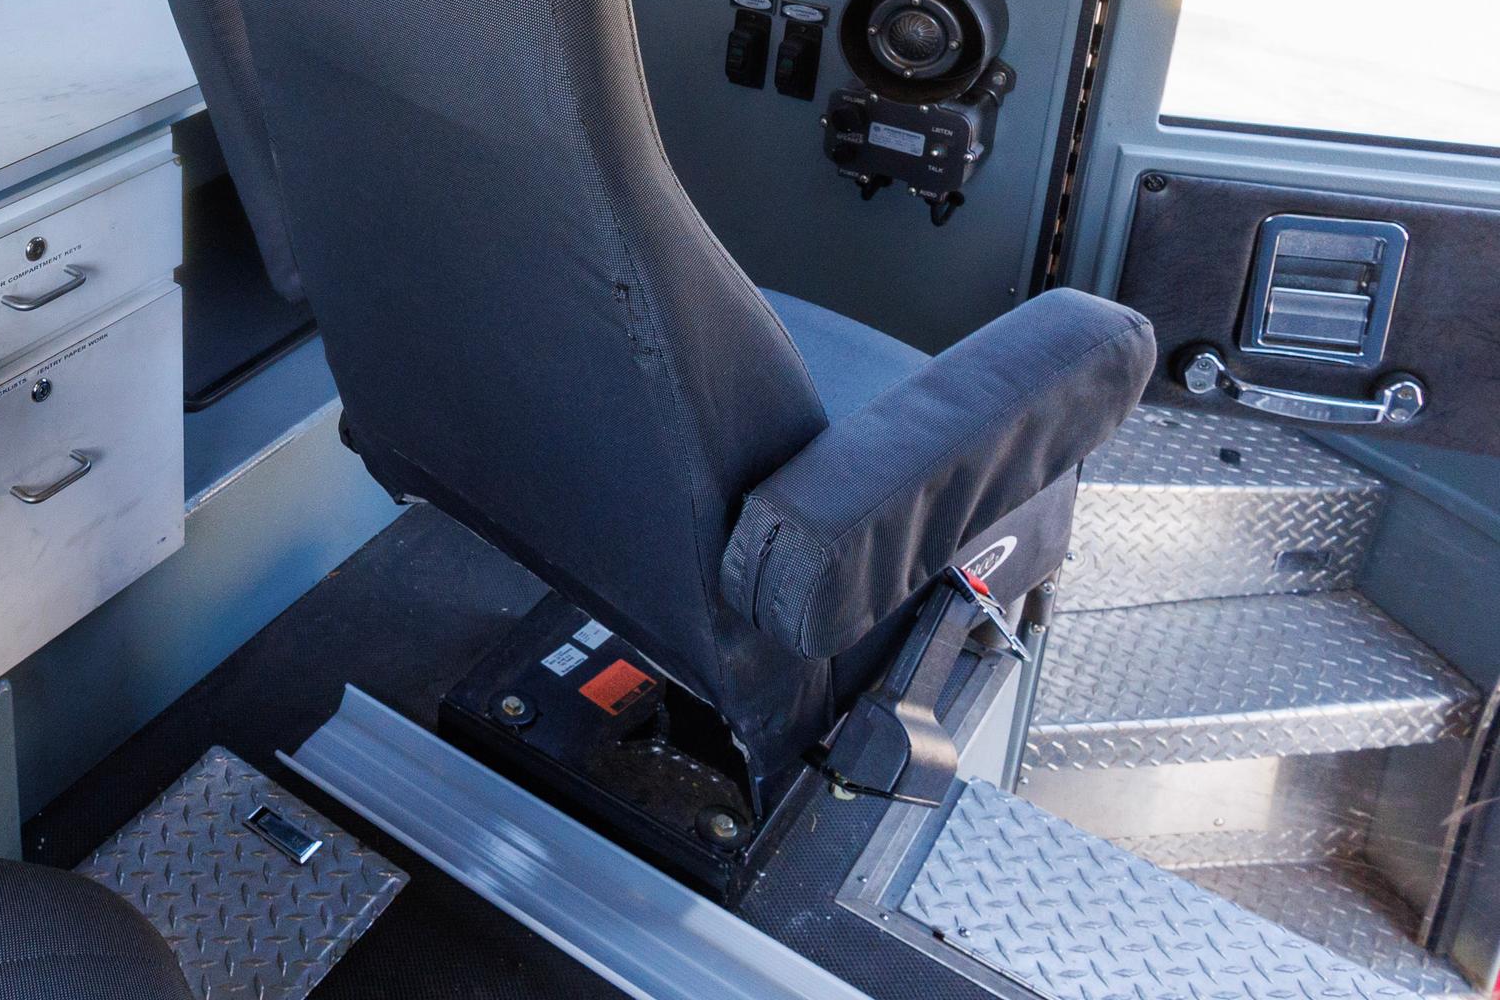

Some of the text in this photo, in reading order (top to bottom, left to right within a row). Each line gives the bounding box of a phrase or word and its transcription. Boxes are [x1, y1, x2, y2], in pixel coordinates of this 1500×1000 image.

[931, 126, 954, 137] LISTEN
[8, 253, 62, 284] COMPARTMENT
[64, 244, 82, 256] KEYS
[64, 344, 87, 360] PAPER
[88, 332, 109, 347] WORK
